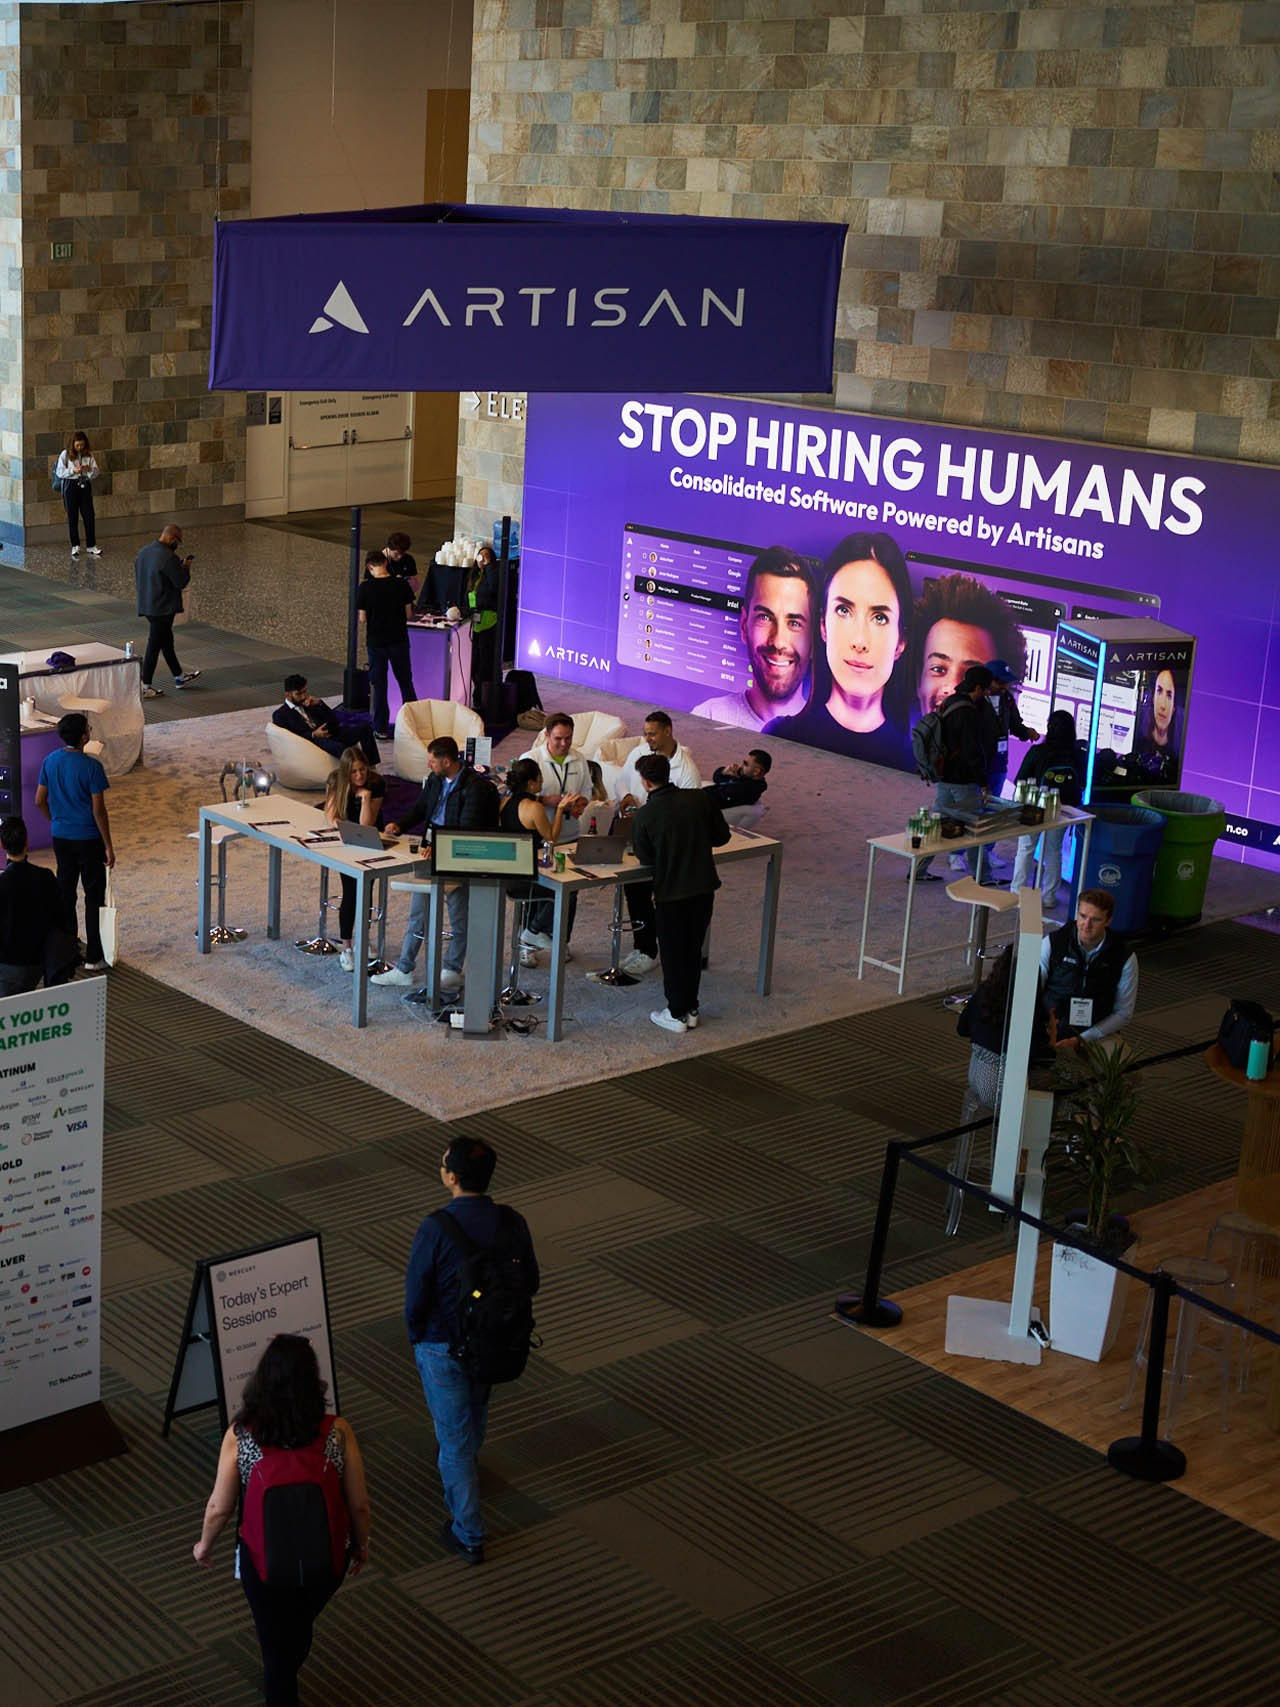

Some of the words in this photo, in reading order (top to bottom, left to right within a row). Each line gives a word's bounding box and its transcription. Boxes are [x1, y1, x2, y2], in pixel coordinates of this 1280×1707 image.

[55, 244, 72, 257] EXIT
[403, 288, 745, 327] ARTISAN
[488, 391, 527, 420] ELE
[619, 400, 737, 461] STOP
[745, 417, 925, 491] HIRING
[937, 443, 1206, 535] HUMANS
[670, 467, 786, 505] Consolidated
[789, 486, 878, 521] Software
[882, 502, 973, 537] Powered
[977, 515, 1004, 547] by
[1007, 522, 1105, 560] Artisans
[545, 646, 610, 672] ARTISAN
[1067, 640, 1098, 659] ARTISAN
[1126, 652, 1187, 662] ARTISAN
[10, 1008, 44, 1028] YOU
[48, 1002, 70, 1018] TO
[66, 1120, 88, 1132] VISA
[229, 1265, 256, 1277] MERCURY
[220, 1286, 267, 1309] Today's
[269, 1276, 309, 1298] Expert
[222, 1307, 277, 1331] Sessions
[59, 1369, 92, 1384] TechCrunch
